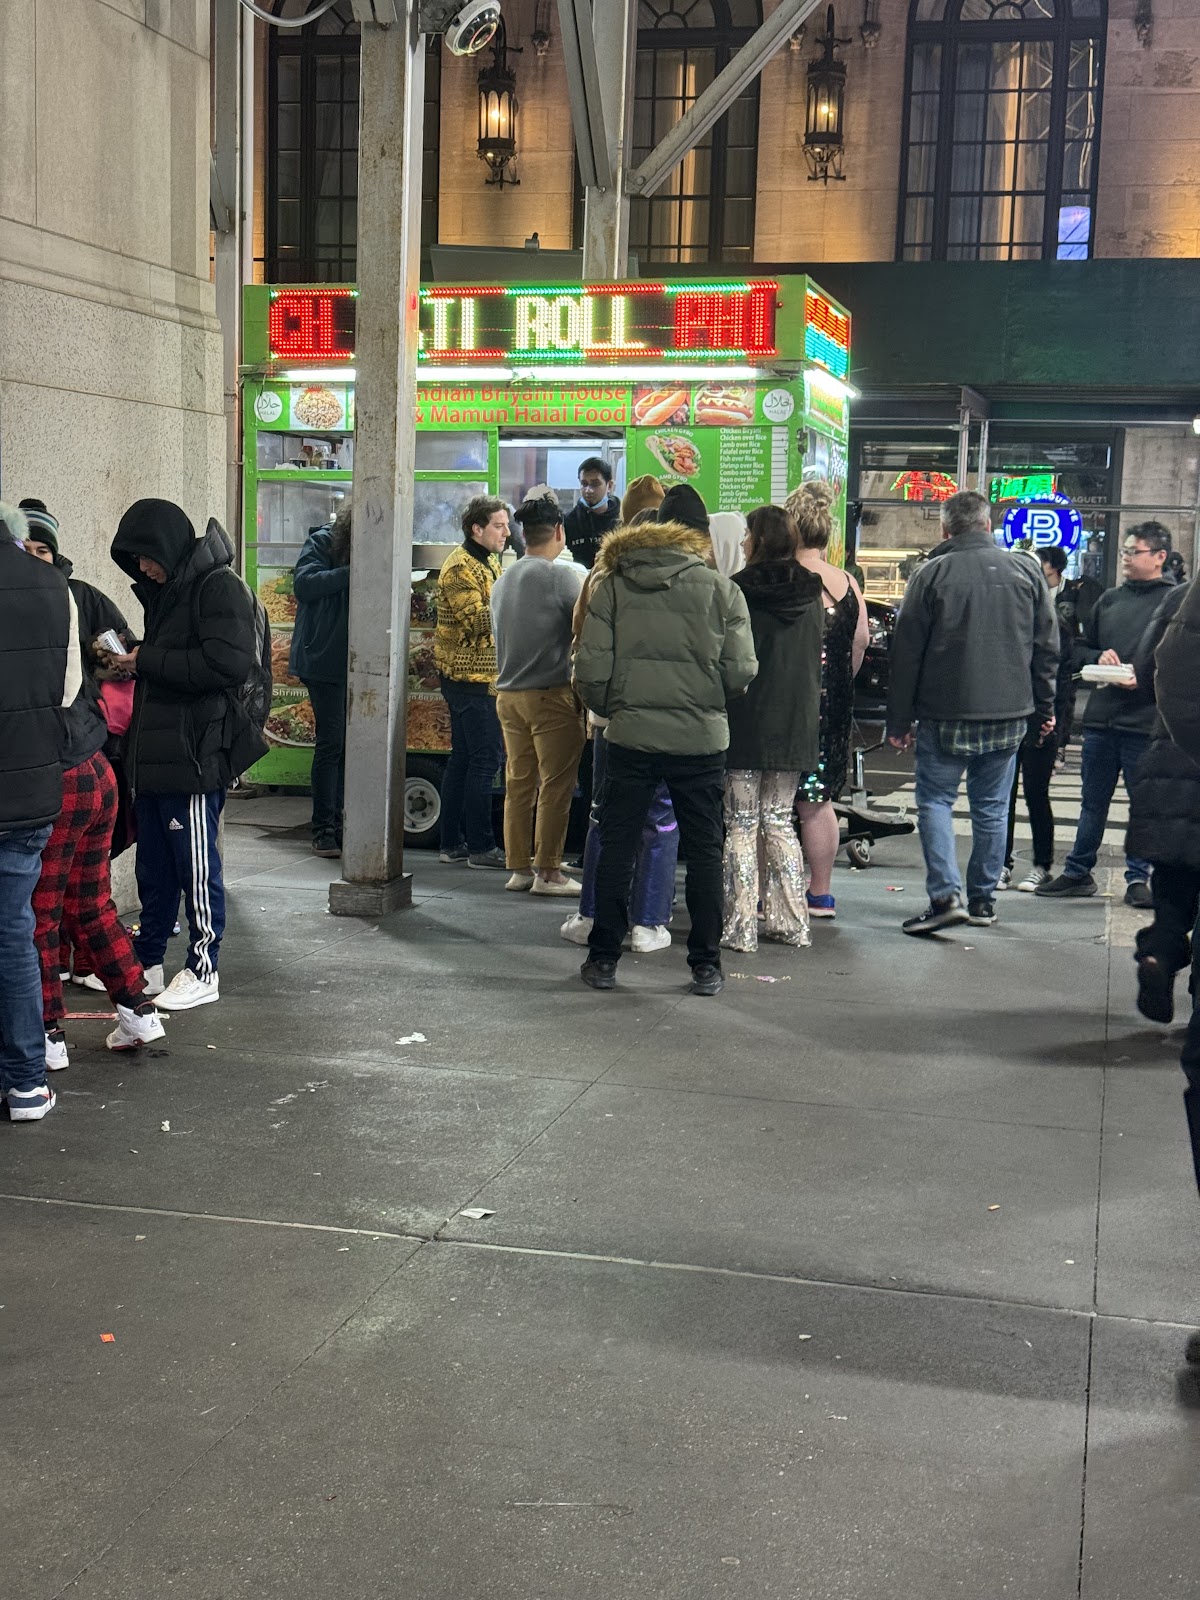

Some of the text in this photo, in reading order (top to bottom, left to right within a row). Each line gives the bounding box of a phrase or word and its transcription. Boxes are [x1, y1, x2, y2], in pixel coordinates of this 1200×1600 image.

[515, 294, 645, 349] ROLL
[416, 385, 475, 401] ndian
[431, 405, 508, 423] Mamun
[514, 404, 567, 423] Halal
[574, 403, 626, 422] Food
[272, 688, 309, 698] Shrimp
